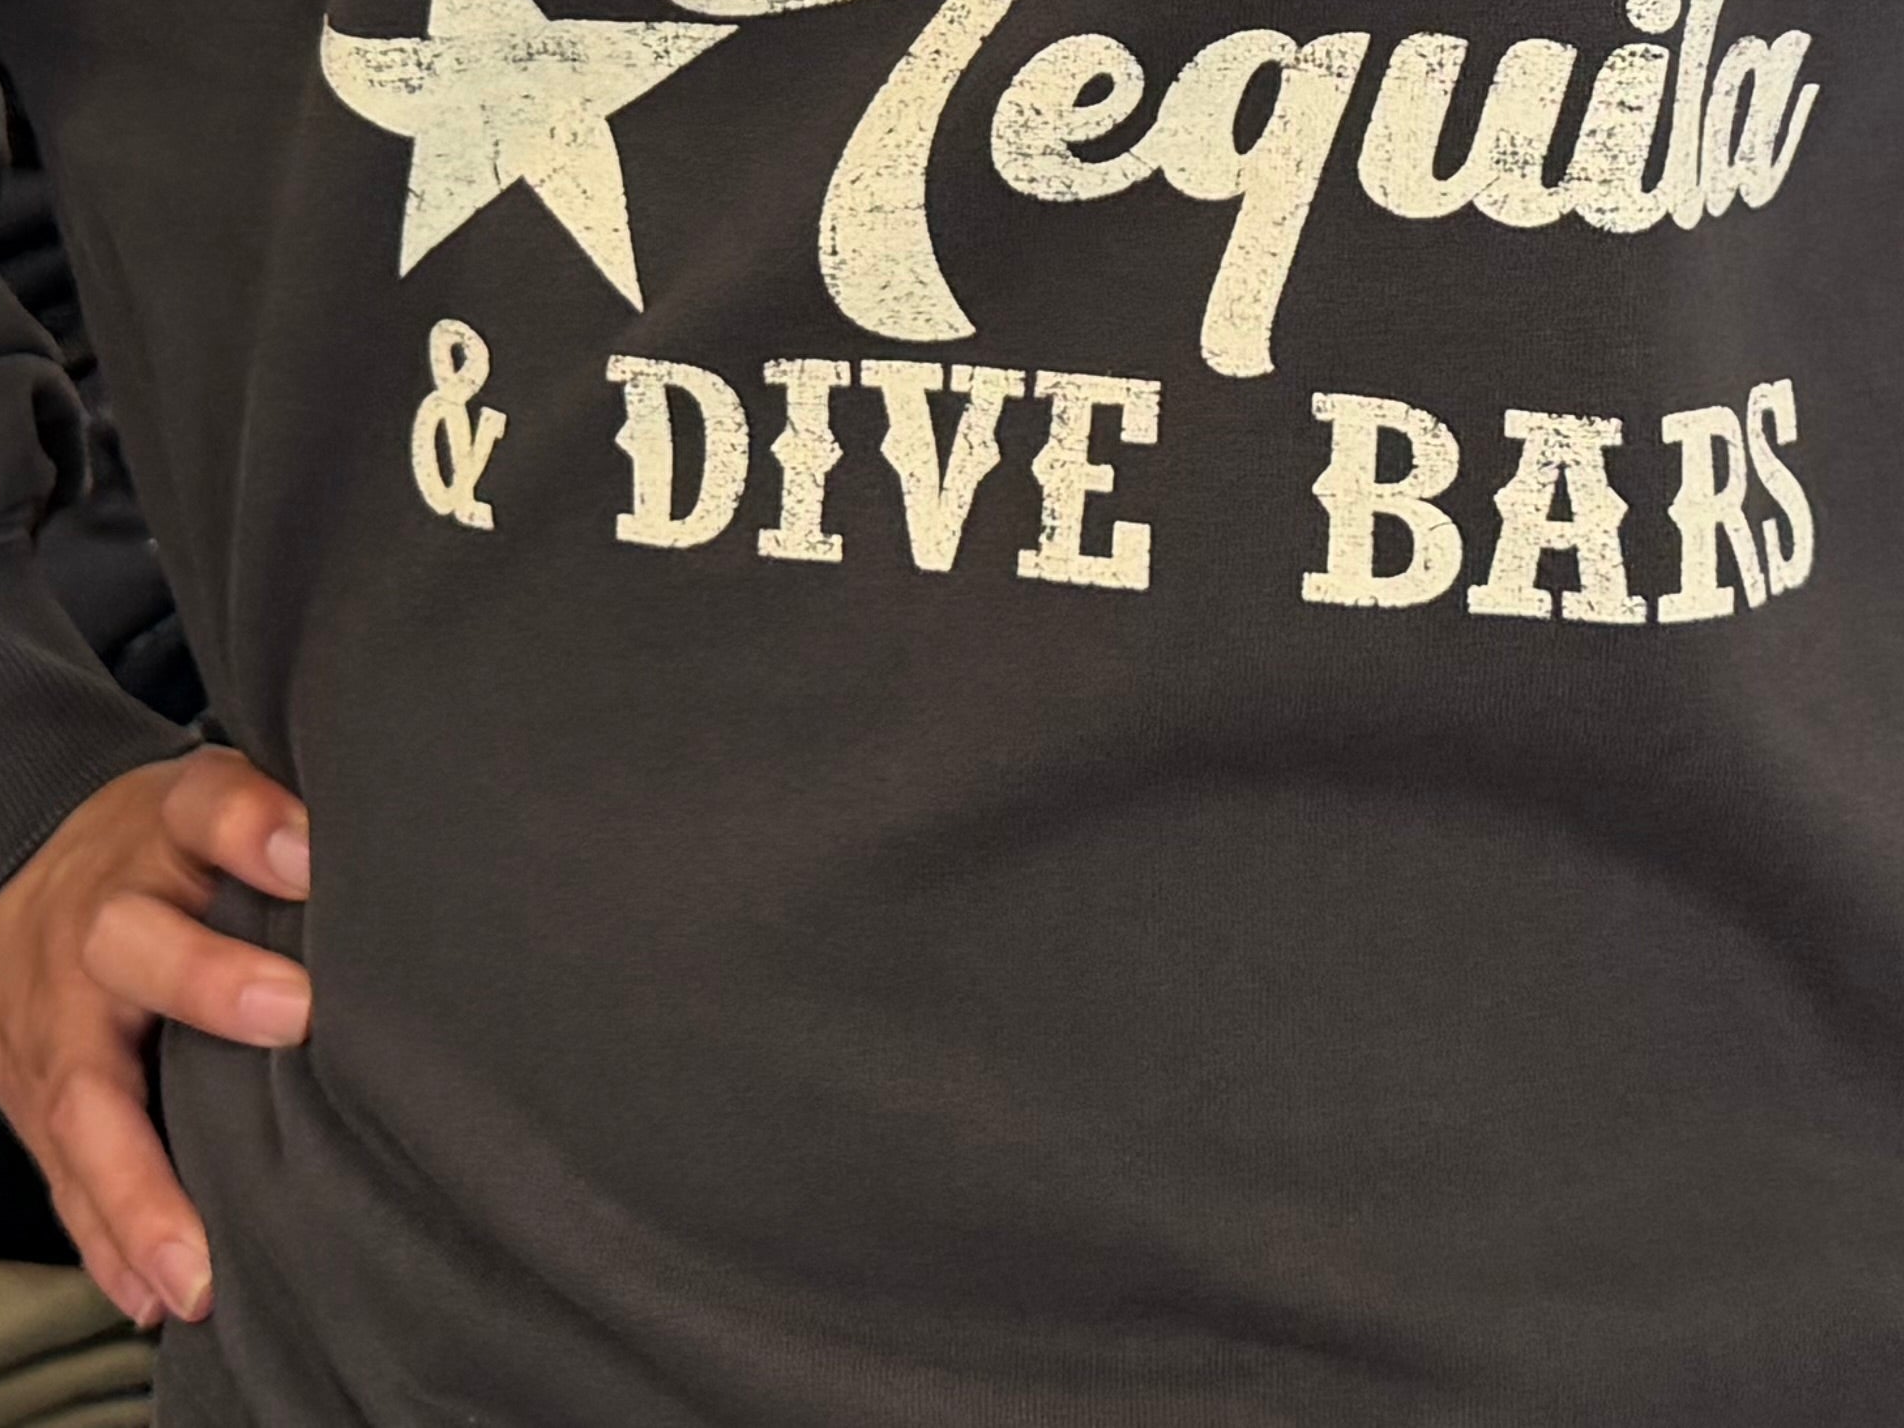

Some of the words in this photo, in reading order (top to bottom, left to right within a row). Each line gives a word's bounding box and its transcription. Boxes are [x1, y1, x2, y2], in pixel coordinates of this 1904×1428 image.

[412, 319, 506, 529] &
[606, 355, 1161, 590] DIVE
[1302, 379, 1816, 624] BARS
